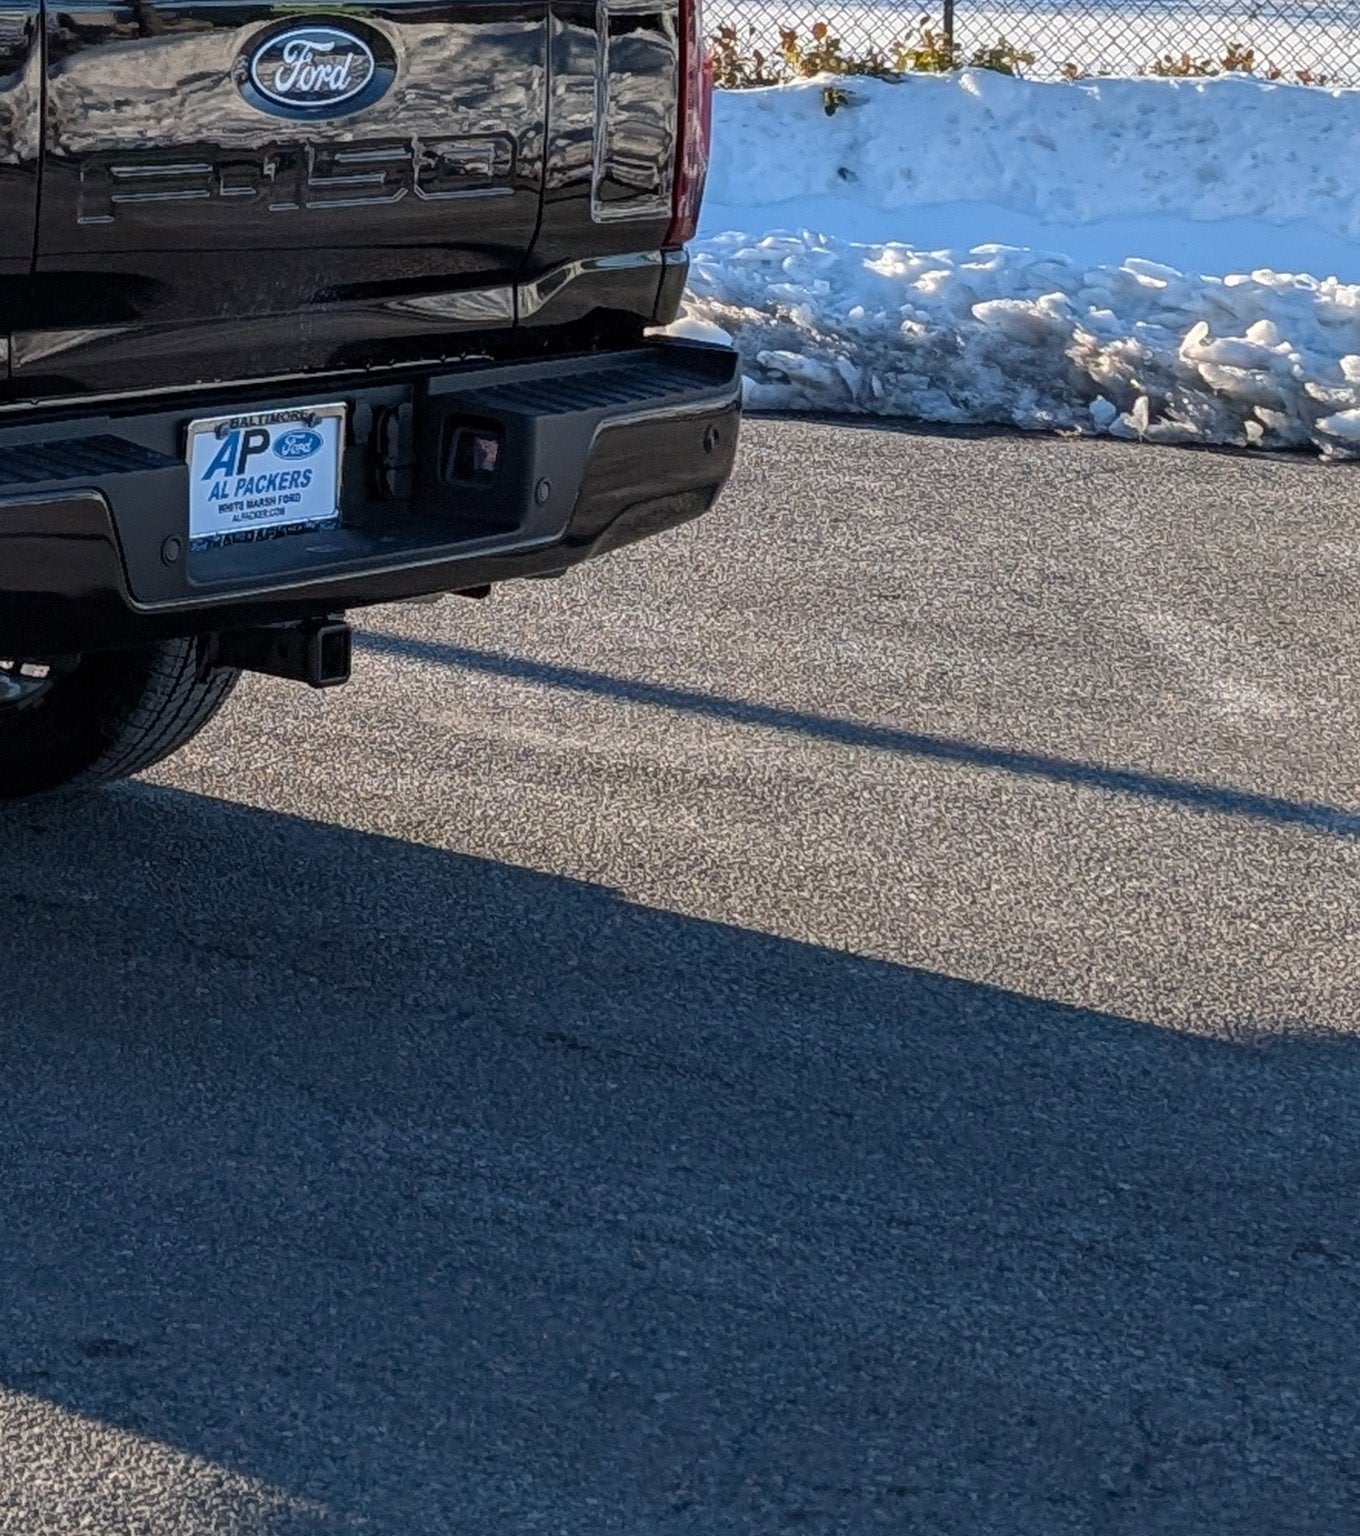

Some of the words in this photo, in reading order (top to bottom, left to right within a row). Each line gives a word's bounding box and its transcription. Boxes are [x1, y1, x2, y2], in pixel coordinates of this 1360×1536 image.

[274, 39, 354, 93] Ford
[201, 428, 270, 481] AP
[281, 434, 314, 456] Ford
[207, 480, 231, 502] AL
[234, 468, 313, 497] PACKERS
[246, 496, 277, 510] MARSH
[278, 492, 302, 505] FORD
